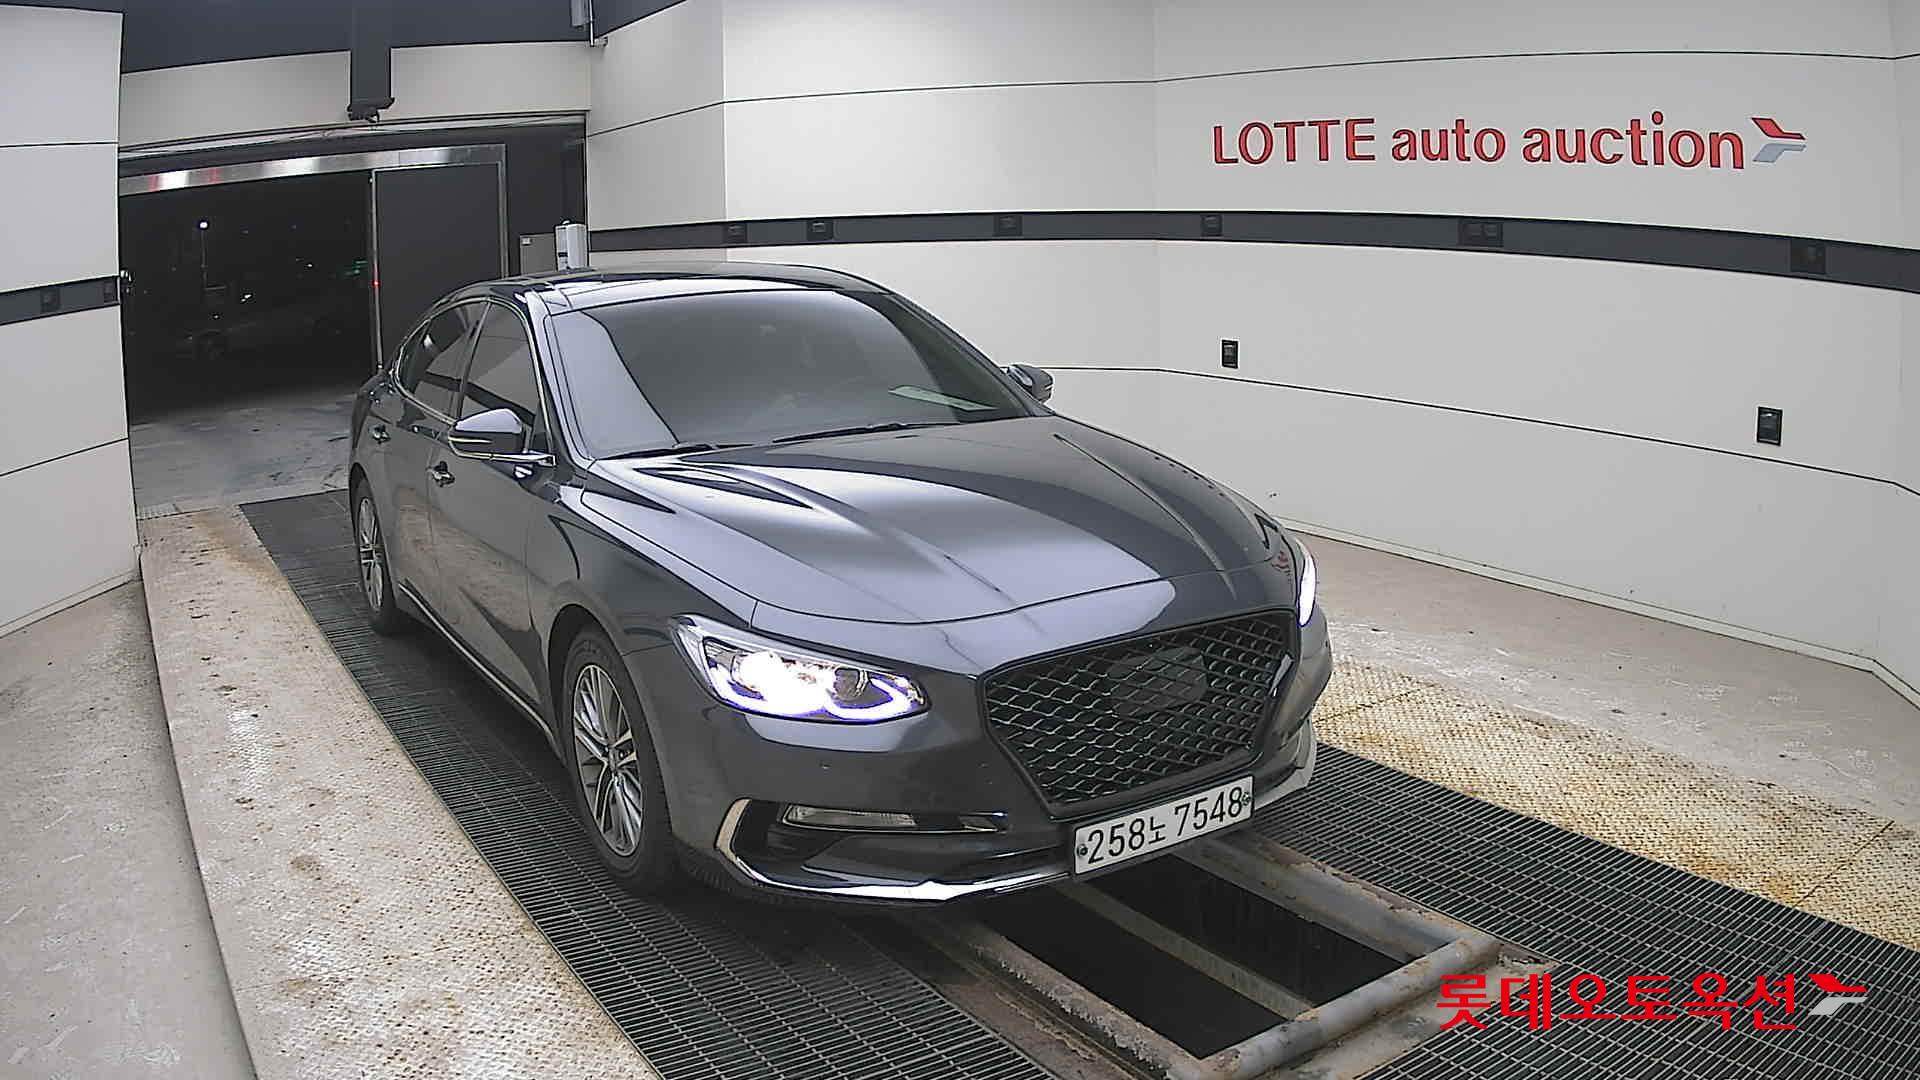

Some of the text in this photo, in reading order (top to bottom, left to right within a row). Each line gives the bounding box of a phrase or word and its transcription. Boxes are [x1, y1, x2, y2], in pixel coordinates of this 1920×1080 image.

[1213, 111, 1745, 169] LOTTE auto auction
[1087, 786, 1243, 865] 258노 7548
